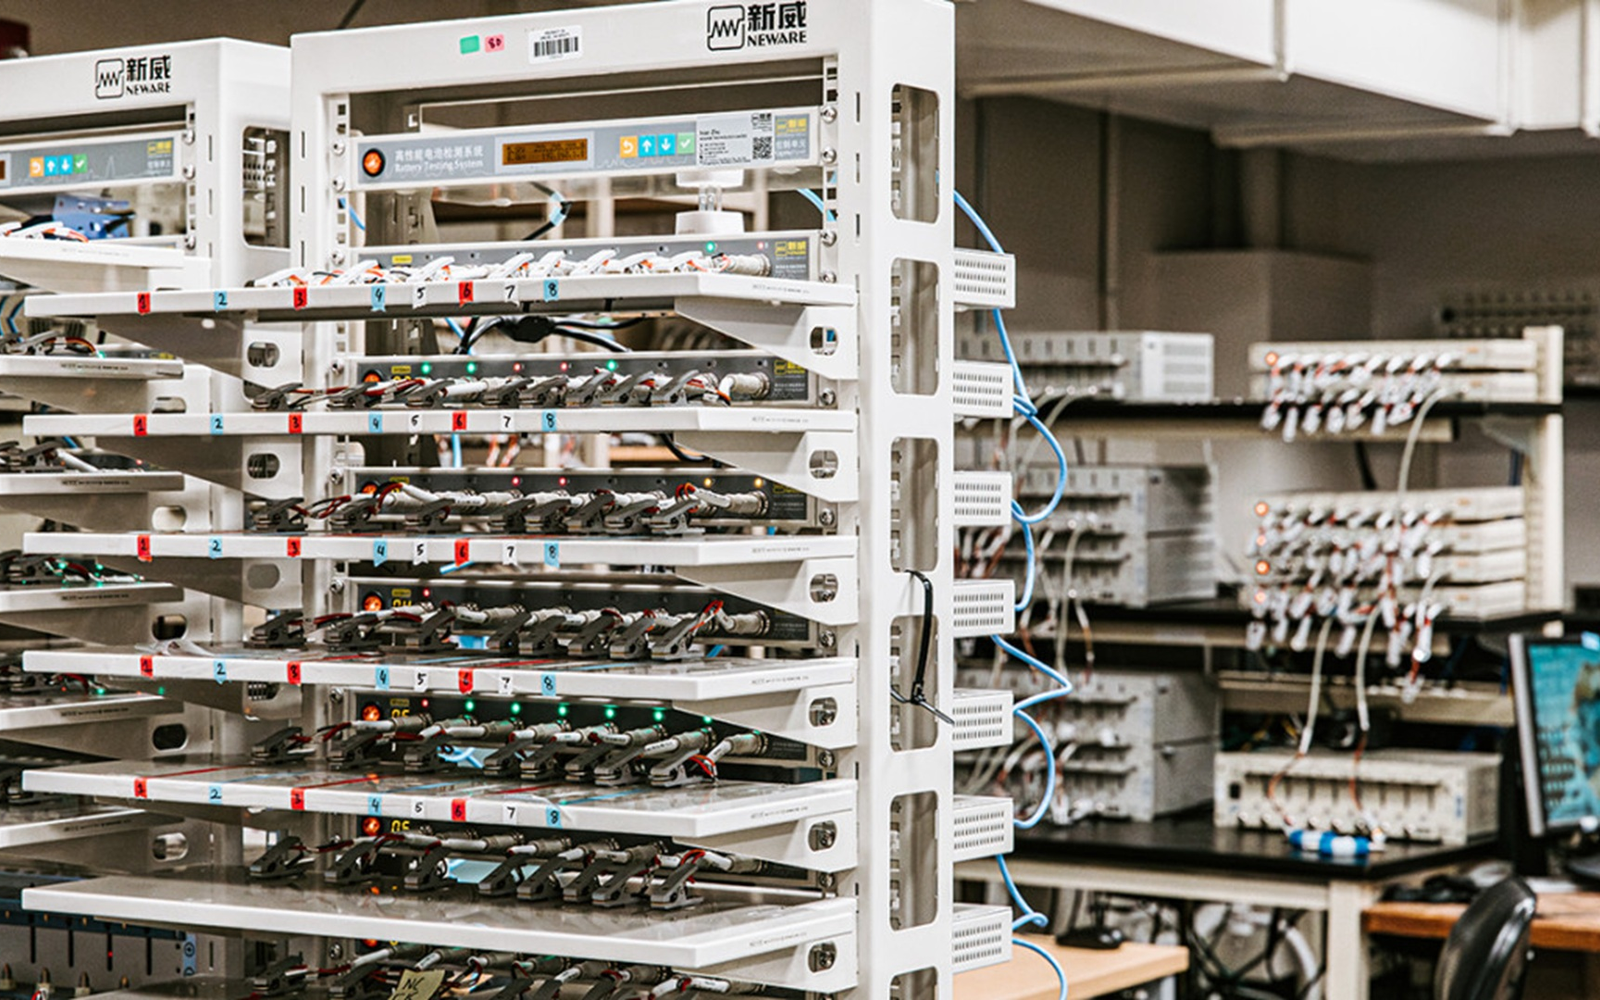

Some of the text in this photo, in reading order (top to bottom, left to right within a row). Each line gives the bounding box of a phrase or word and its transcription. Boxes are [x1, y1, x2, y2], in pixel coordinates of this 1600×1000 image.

[747, 1, 807, 32] 新威
[747, 31, 808, 48] NEWARE
[125, 55, 172, 82] 新威
[125, 81, 172, 96] NEWARE
[217, 292, 228, 306] 2
[296, 292, 304, 307] 3
[375, 287, 383, 302] 4
[416, 286, 427, 300] 5
[463, 282, 471, 298] 6
[504, 285, 516, 299] 7
[548, 282, 557, 297] 8
[135, 417, 145, 432] 1
[214, 418, 224, 430] 2
[291, 416, 300, 429] 3
[411, 414, 420, 426] 5
[455, 413, 463, 427] 6
[502, 415, 511, 429] 7
[546, 412, 555, 428] 8
[211, 540, 222, 552] 2
[290, 541, 299, 555] 3
[376, 545, 385, 556] 4
[416, 543, 425, 556] 5
[506, 545, 515, 557] 7
[549, 545, 557, 559] 8
[142, 659, 153, 673] 1
[216, 662, 226, 675] 2
[289, 664, 299, 678] 3
[379, 669, 387, 685] 4
[416, 672, 427, 685] 5
[543, 675, 554, 691] 8
[210, 788, 222, 800] 2
[371, 797, 380, 812] 4
[415, 801, 424, 813] 5
[454, 803, 463, 816] 6
[507, 806, 516, 820] 7
[550, 809, 560, 824] 8
